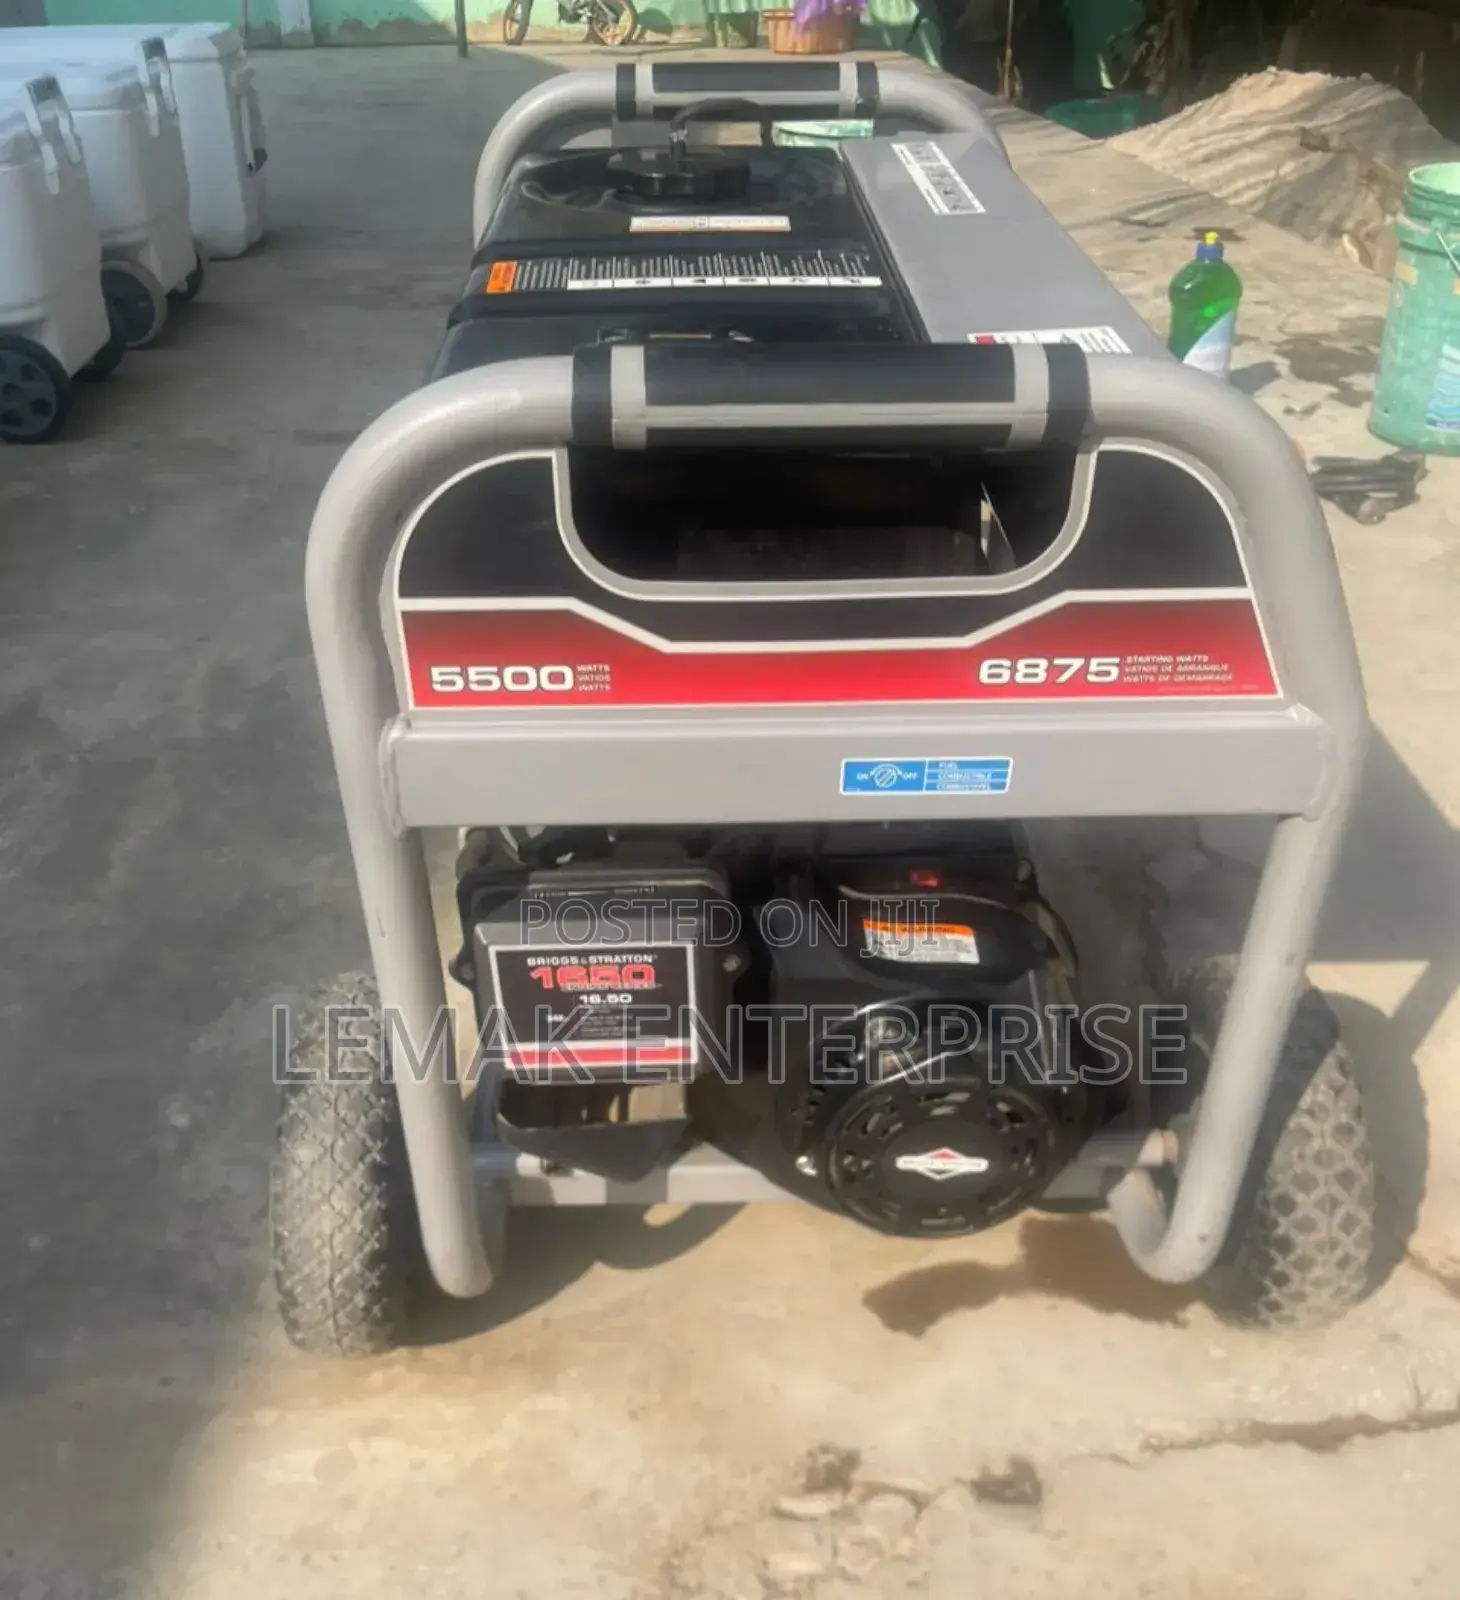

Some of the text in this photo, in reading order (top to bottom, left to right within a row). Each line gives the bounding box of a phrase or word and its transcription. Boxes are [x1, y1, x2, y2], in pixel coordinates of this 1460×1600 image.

[1176, 655, 1209, 663] WATTS
[576, 664, 610, 672] WATTS
[979, 657, 1120, 684] 6875
[430, 665, 574, 692] 5500
[527, 956, 579, 967] BRIGGS
[588, 954, 653, 965] STRATTON
[529, 964, 656, 989] 1650
[579, 993, 633, 1005] 16.50
